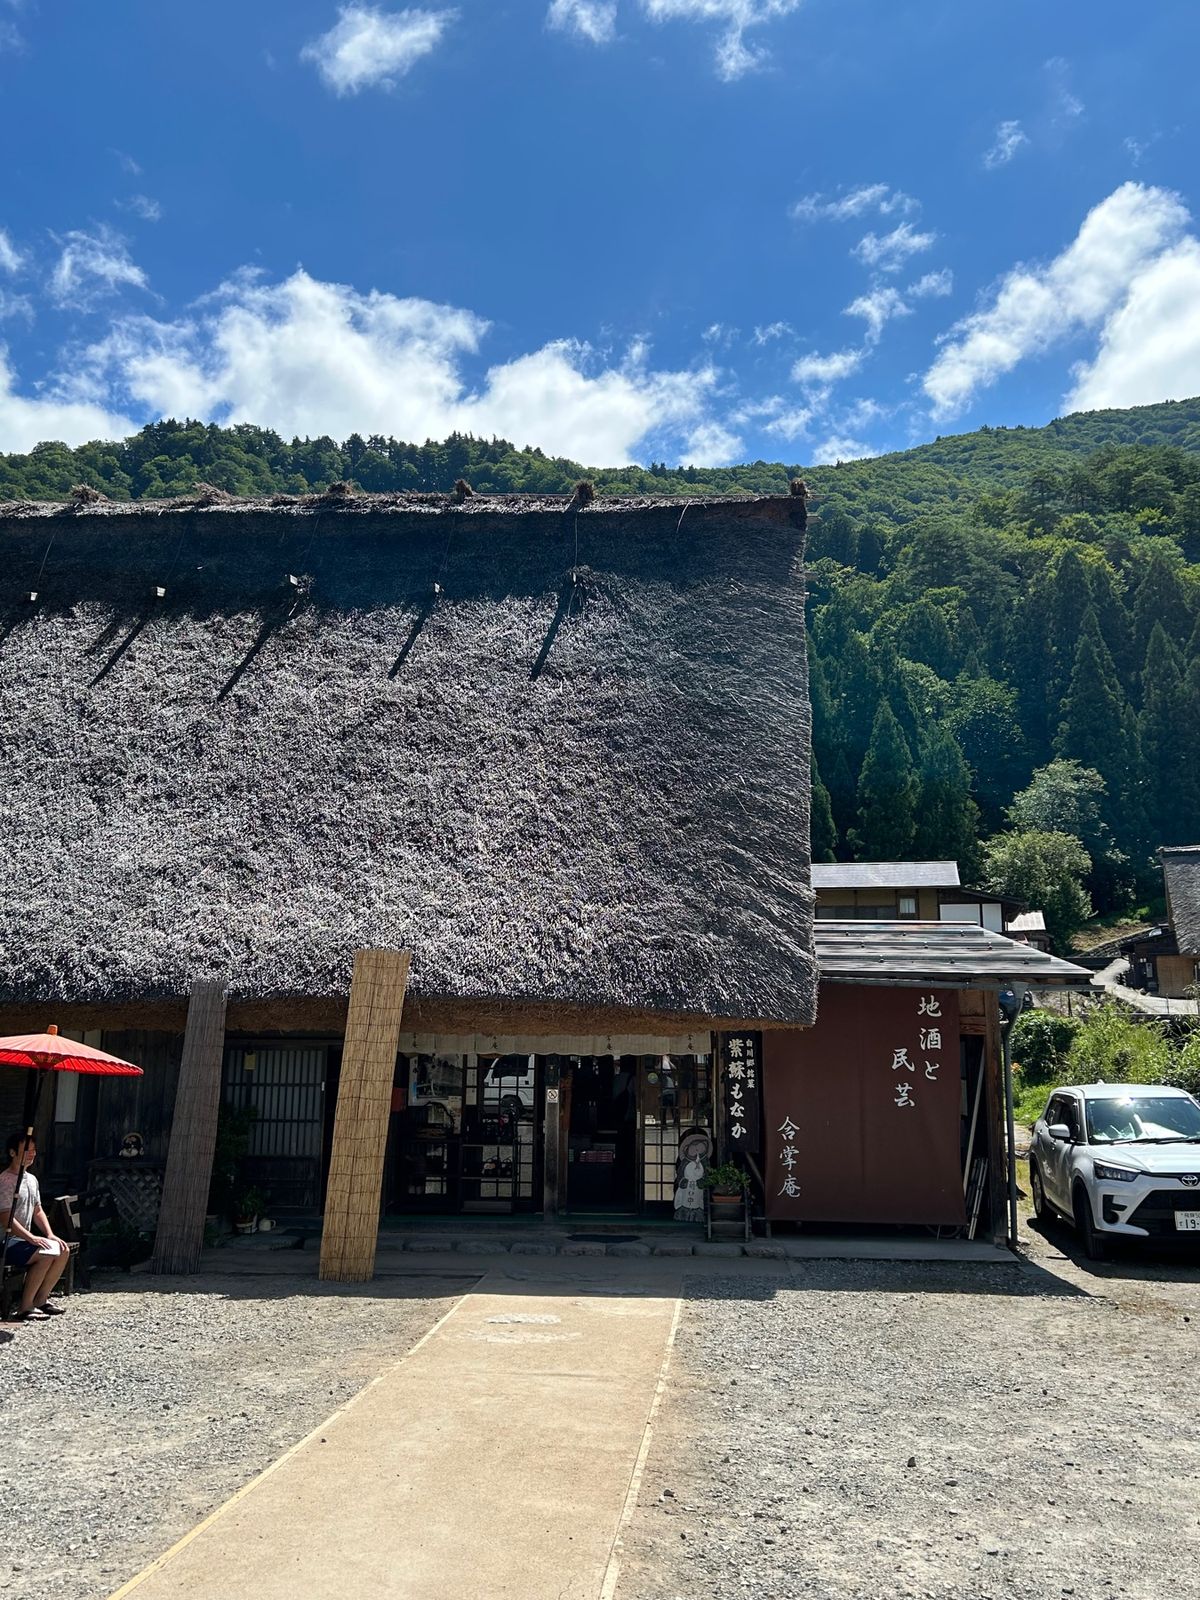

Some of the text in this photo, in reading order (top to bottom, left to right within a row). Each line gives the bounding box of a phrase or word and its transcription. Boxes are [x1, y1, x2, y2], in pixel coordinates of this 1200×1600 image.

[891, 1047, 915, 1107] 民芸
[917, 994, 942, 1081] 地酒と
[728, 1037, 747, 1139] 紫蘇もなか
[777, 1115, 801, 1198] 合掌庵
